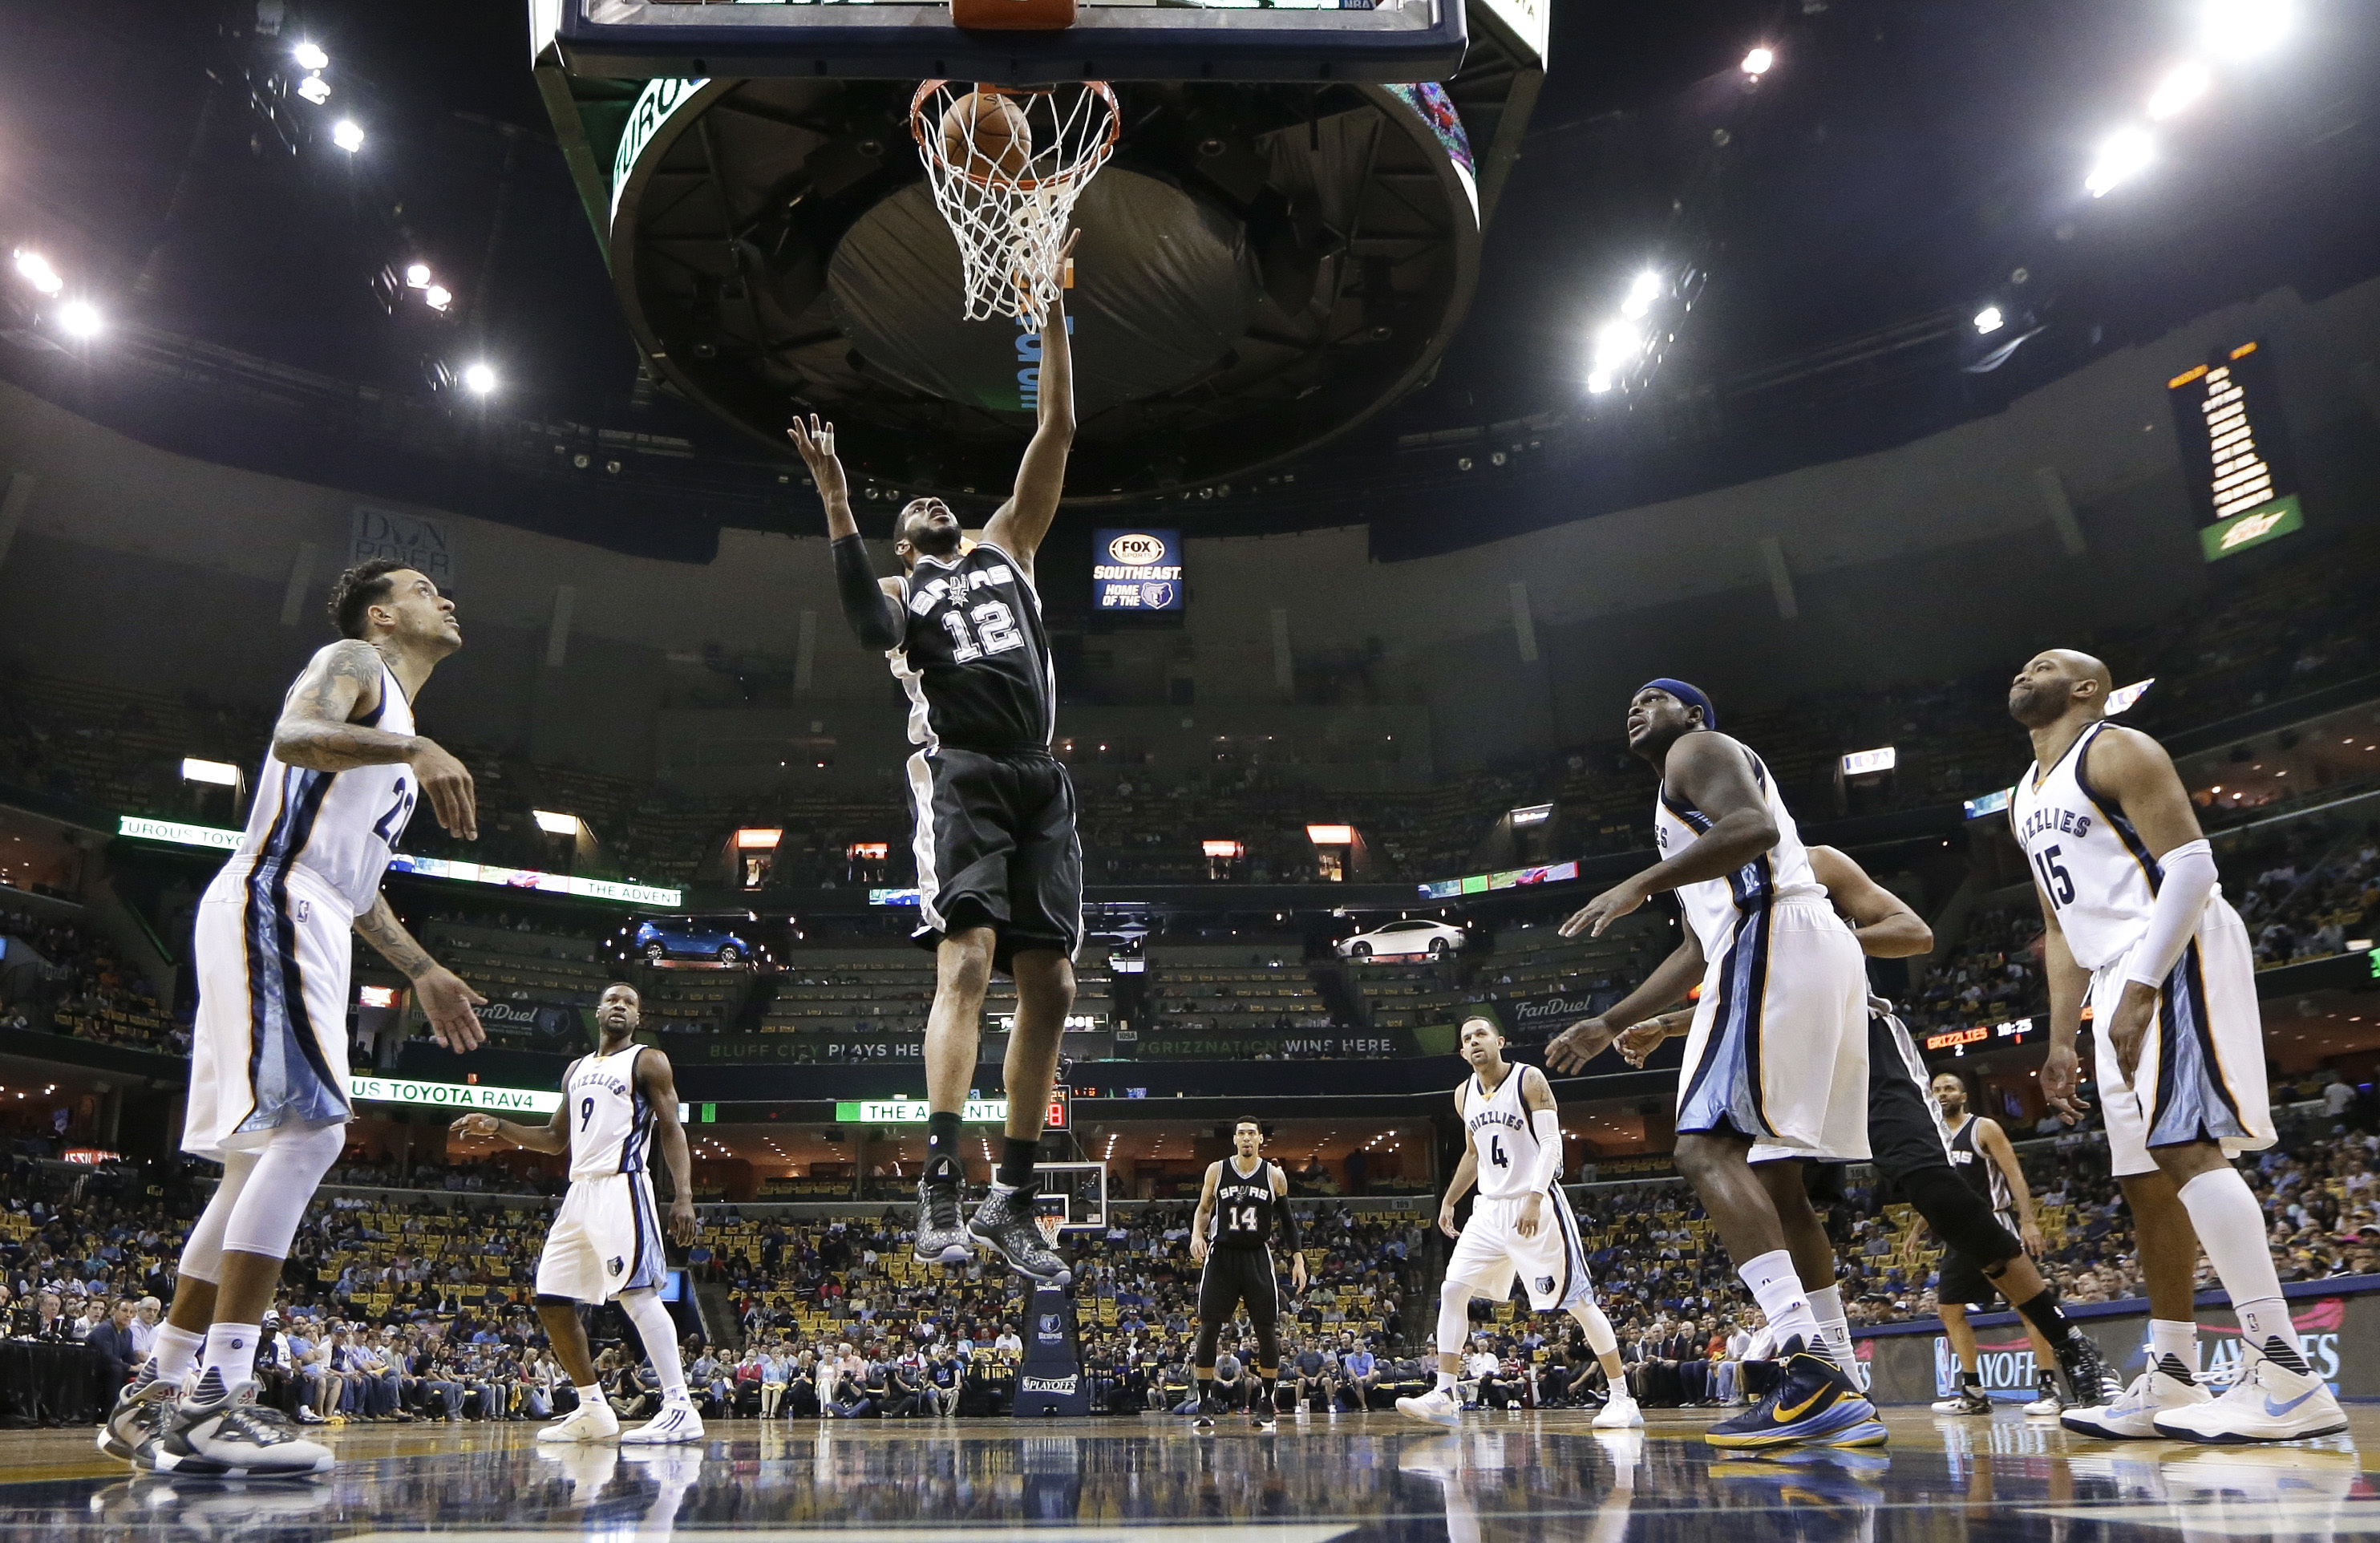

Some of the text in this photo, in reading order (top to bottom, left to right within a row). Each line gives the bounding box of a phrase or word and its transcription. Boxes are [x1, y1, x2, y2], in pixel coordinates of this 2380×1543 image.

[1122, 541, 1152, 553] FOX
[1105, 584, 1139, 595] HOME
[1102, 595, 1141, 606] OF THE
[941, 600, 1026, 665] 12
[2034, 844, 2076, 911] 15
[588, 883, 681, 904] THE ADVENT
[1516, 994, 1591, 1021] FanDuel
[1135, 1041, 1277, 1054] #GRIZZNATON
[1927, 1027, 1988, 1051] GRIZZLIES
[710, 1044, 769, 1057] BLUFF
[1954, 1043, 1964, 1057] 2
[390, 1083, 473, 1104] TOYOTA
[482, 1090, 533, 1108] RAV4
[581, 1096, 595, 1132] 9
[868, 1105, 907, 1119] THE
[1492, 1135, 1508, 1168] 4
[1220, 1185, 1269, 1203] SPURS
[1228, 1206, 1257, 1231] 14
[1029, 1379, 1076, 1391] PLAYOFFS
